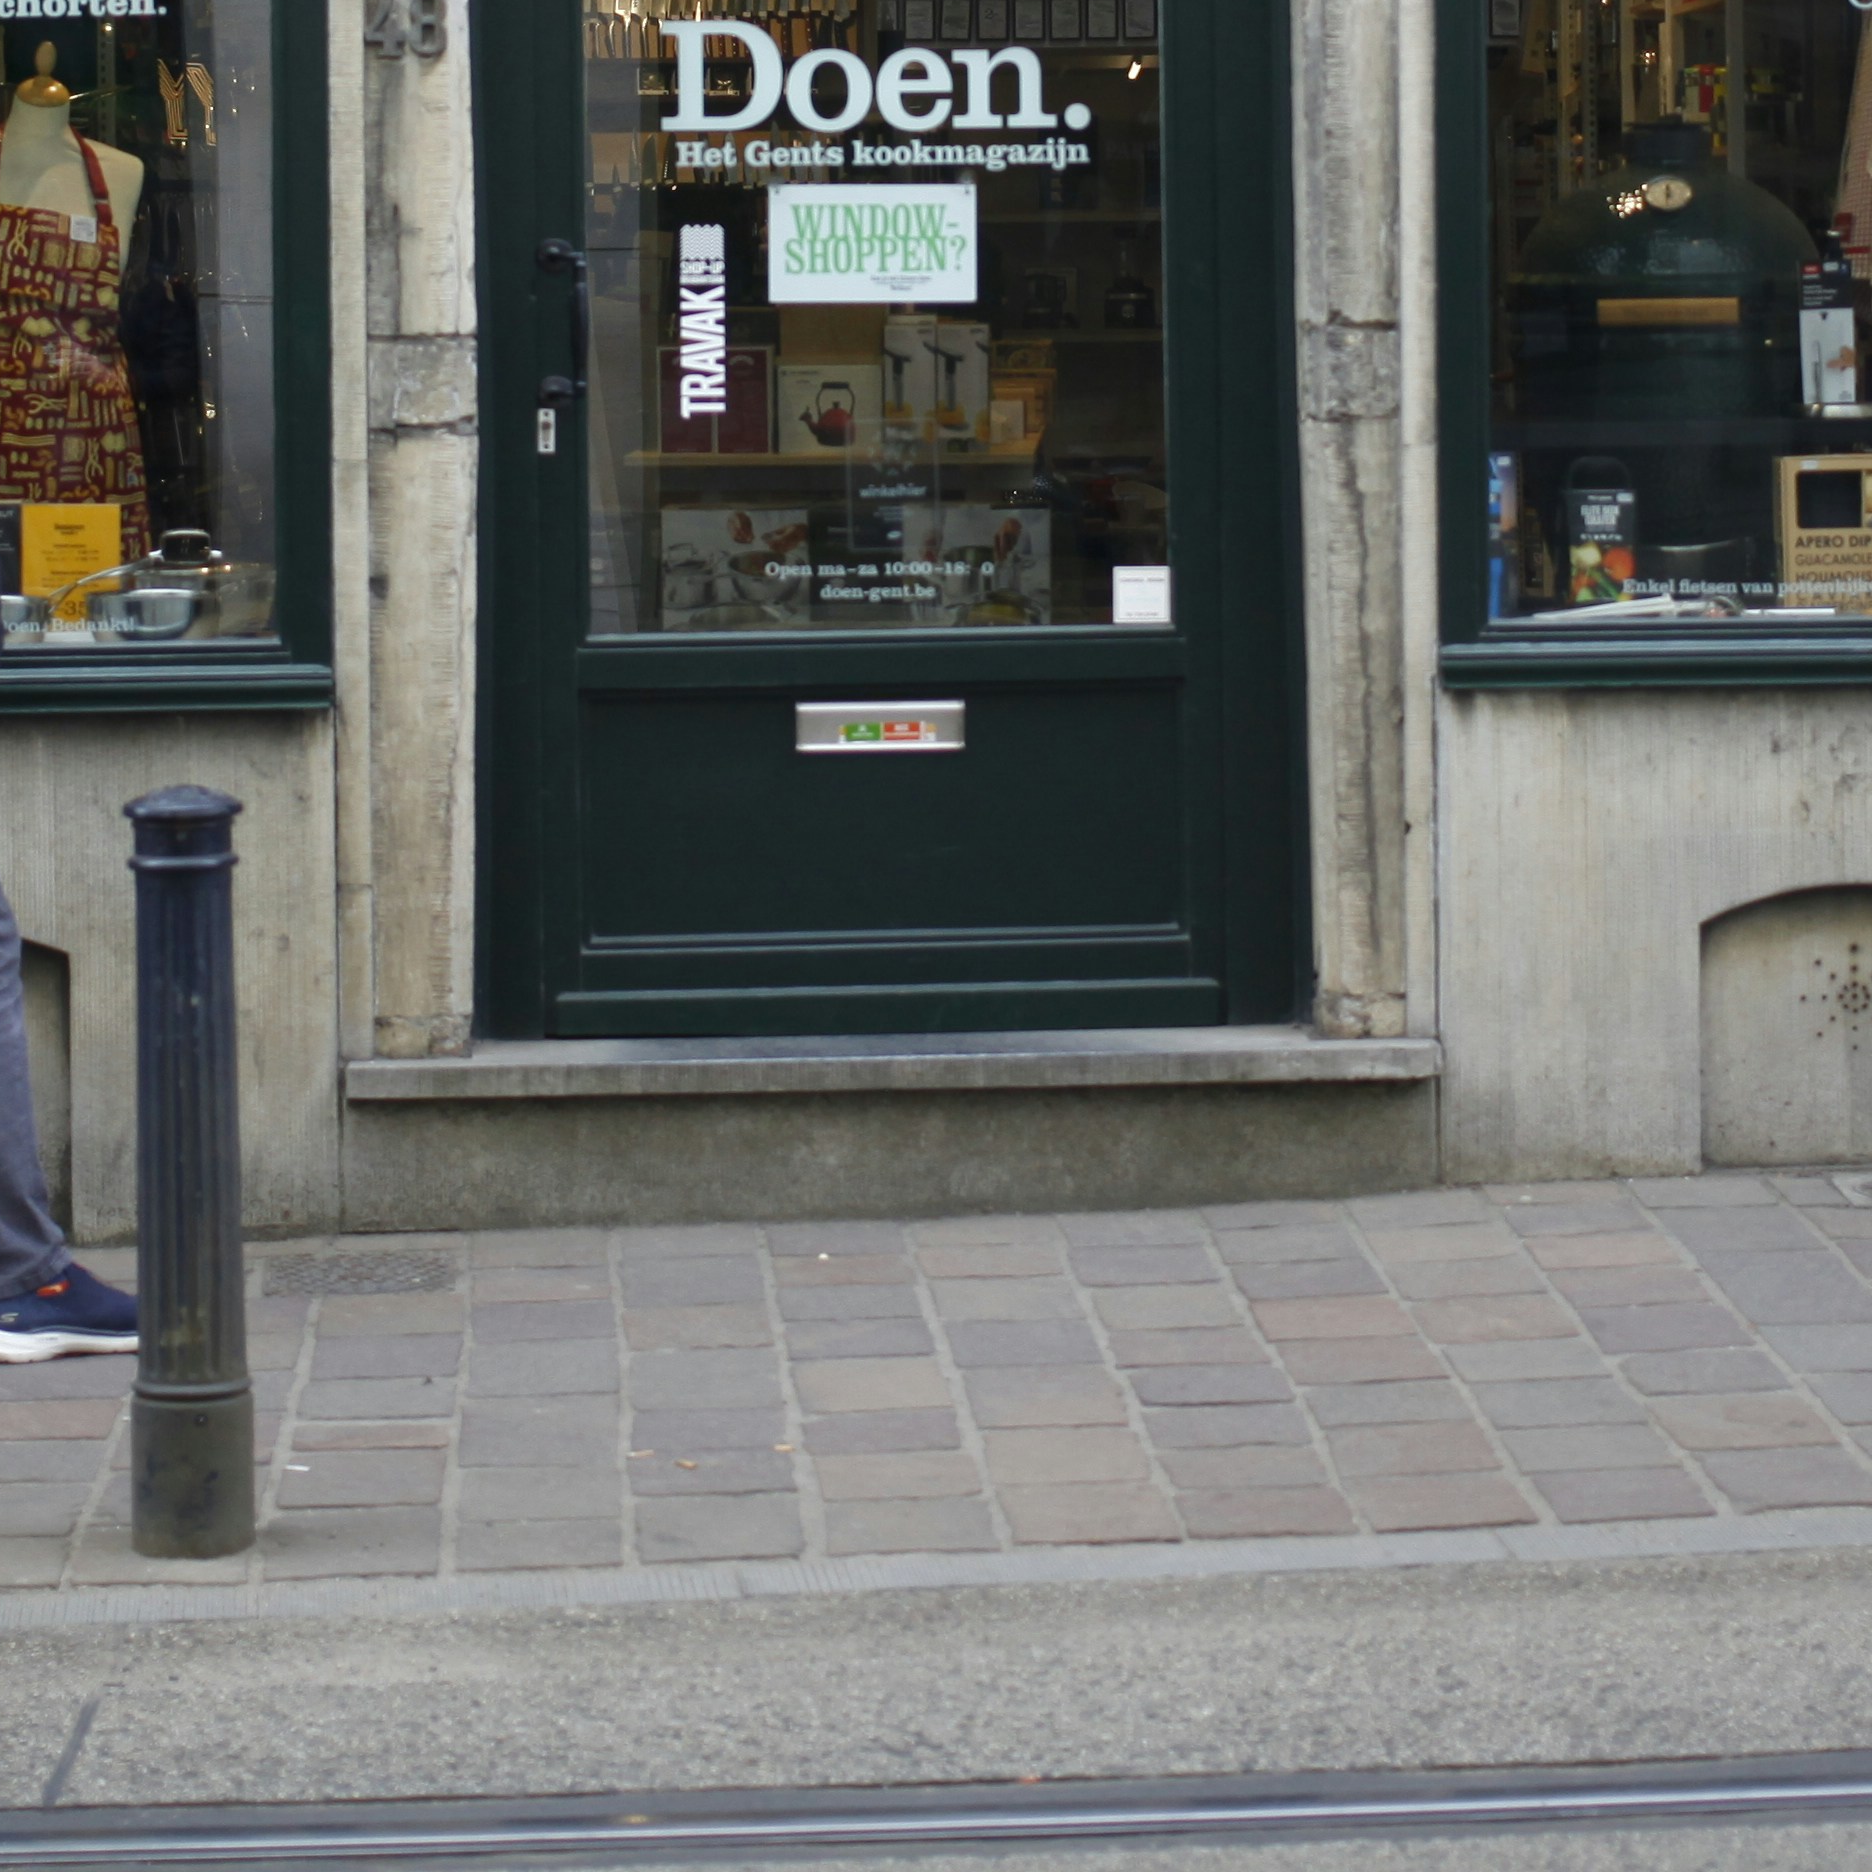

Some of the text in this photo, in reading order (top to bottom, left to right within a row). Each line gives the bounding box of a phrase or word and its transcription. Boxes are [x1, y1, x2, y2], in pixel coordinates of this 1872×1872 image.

[660, 20, 1091, 132] Doen.
[676, 141, 736, 168] Het
[745, 140, 845, 167] Gents
[852, 138, 1090, 171] kookmagazijn
[791, 203, 957, 239] WINDOW-
[784, 235, 967, 275] SHOPPEN?
[679, 285, 726, 419] TRAVAK
[1795, 536, 1844, 548] APERO
[1849, 535, 1872, 547] DIP
[765, 562, 813, 580] Open
[1795, 553, 1872, 566] GUACAMOLE
[820, 584, 936, 602] doen-gent.be
[1622, 578, 1675, 594] Enkel
[1741, 582, 1773, 594] van
